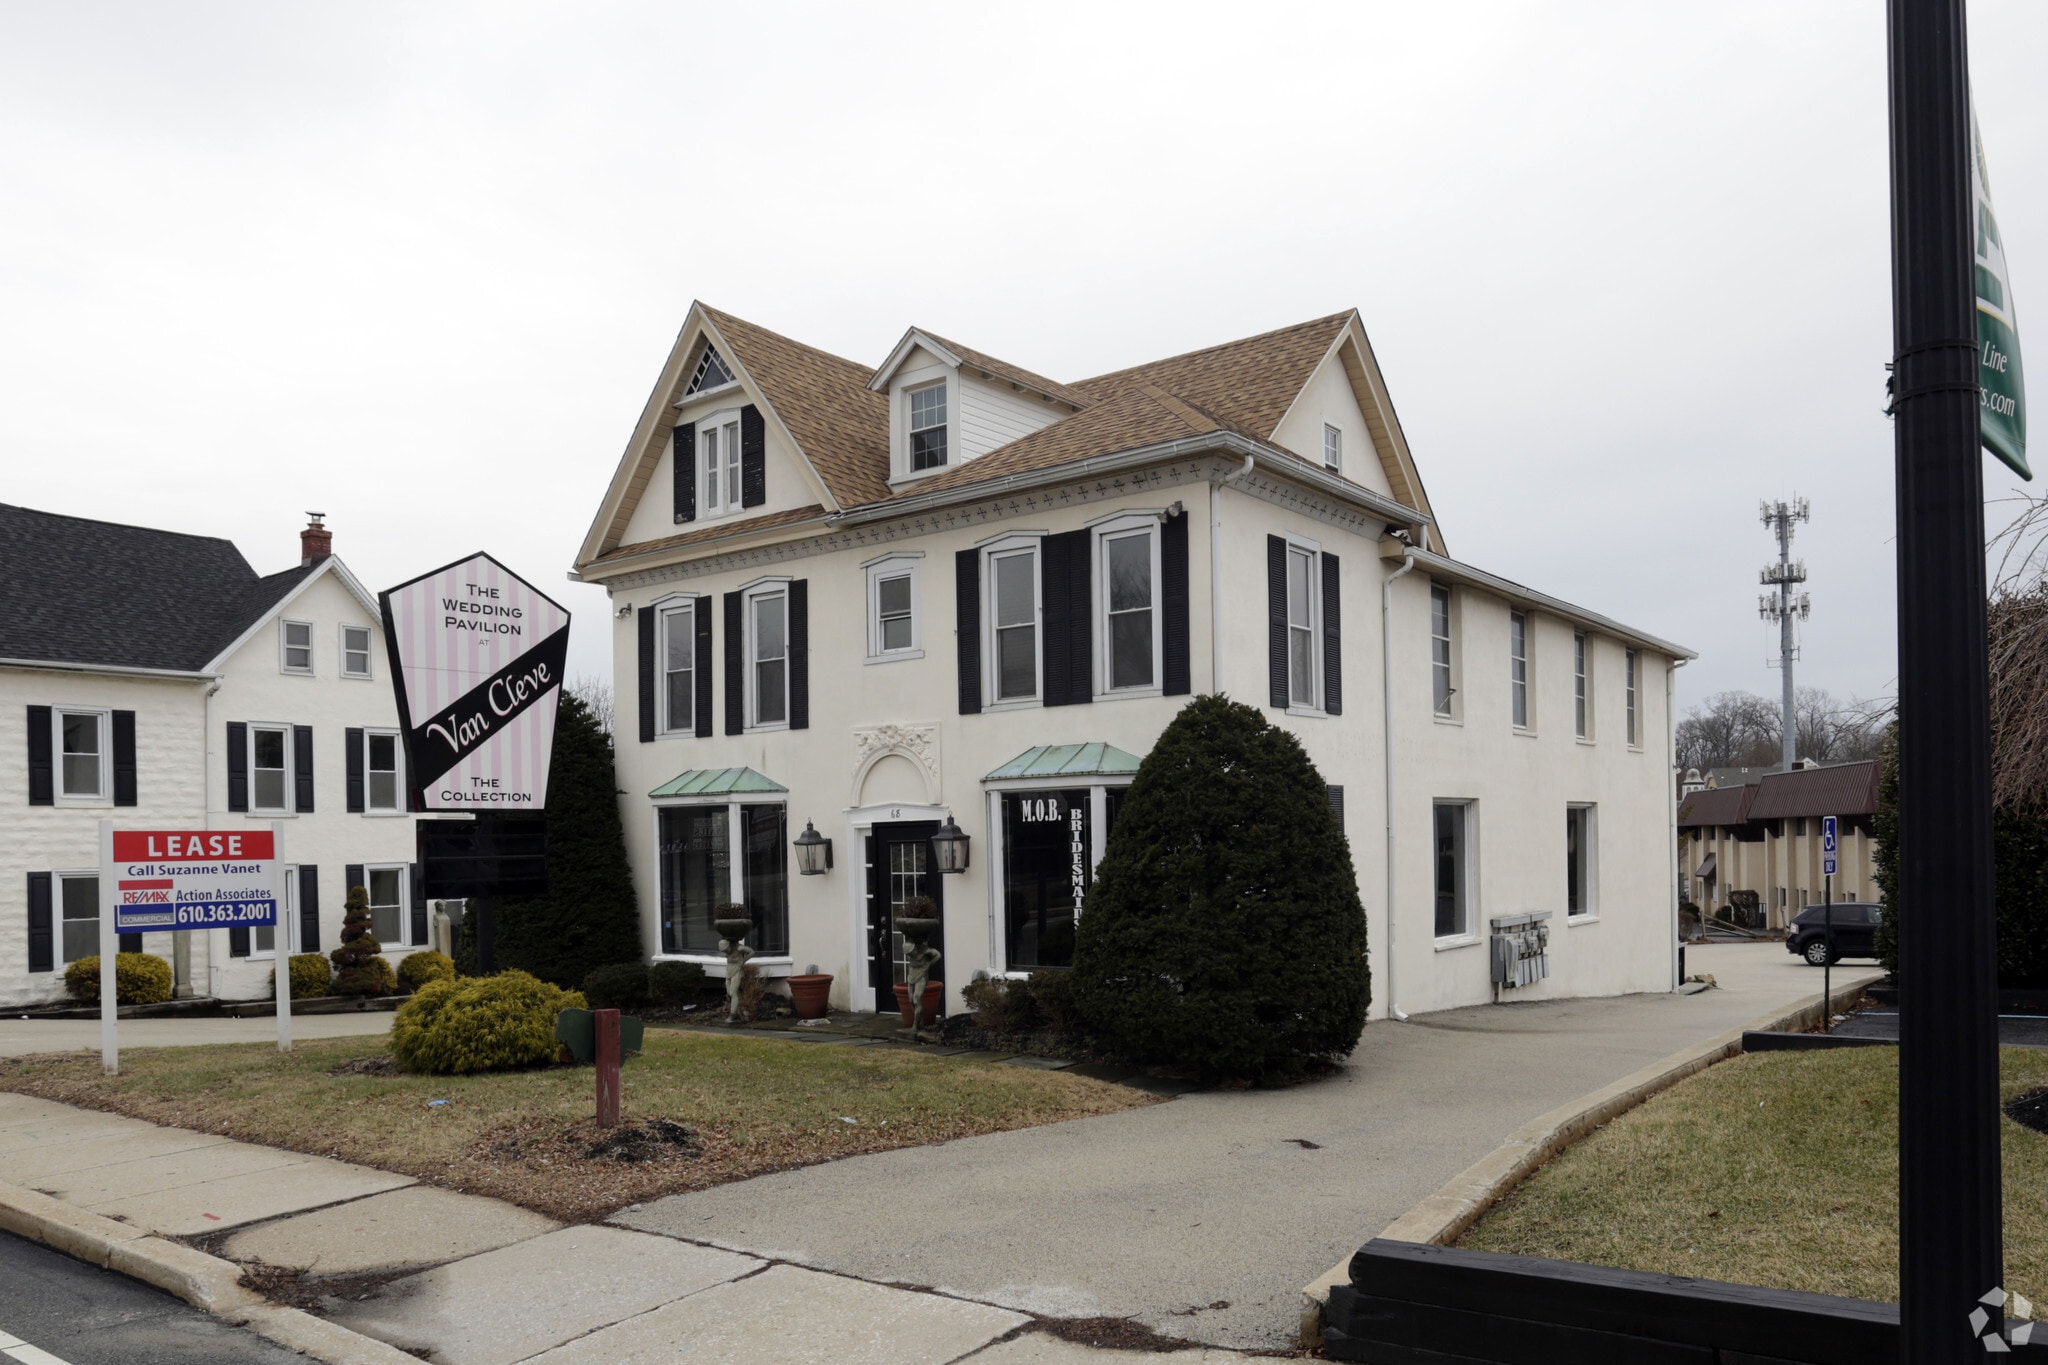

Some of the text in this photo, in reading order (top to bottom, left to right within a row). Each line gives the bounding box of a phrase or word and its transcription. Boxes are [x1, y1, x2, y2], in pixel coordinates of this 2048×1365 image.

[1982, 340, 2008, 373] Line
[1980, 387, 2016, 417] s.com
[466, 583, 500, 599] THE
[442, 598, 523, 619] WEDDING
[445, 616, 522, 635] PAVILION
[426, 662, 551, 753] Van Cleve
[471, 777, 500, 788] THE
[441, 790, 532, 802] COLLECTION
[1022, 799, 1062, 822] M.O.B.
[147, 835, 243, 857] LEASE
[128, 863, 262, 876] Call Suzanne Vanet
[123, 890, 170, 904] RE/MAX
[176, 887, 272, 902] Action Associates
[122, 914, 173, 925] COMMERCIAL
[178, 903, 271, 924] 610.363.2001
